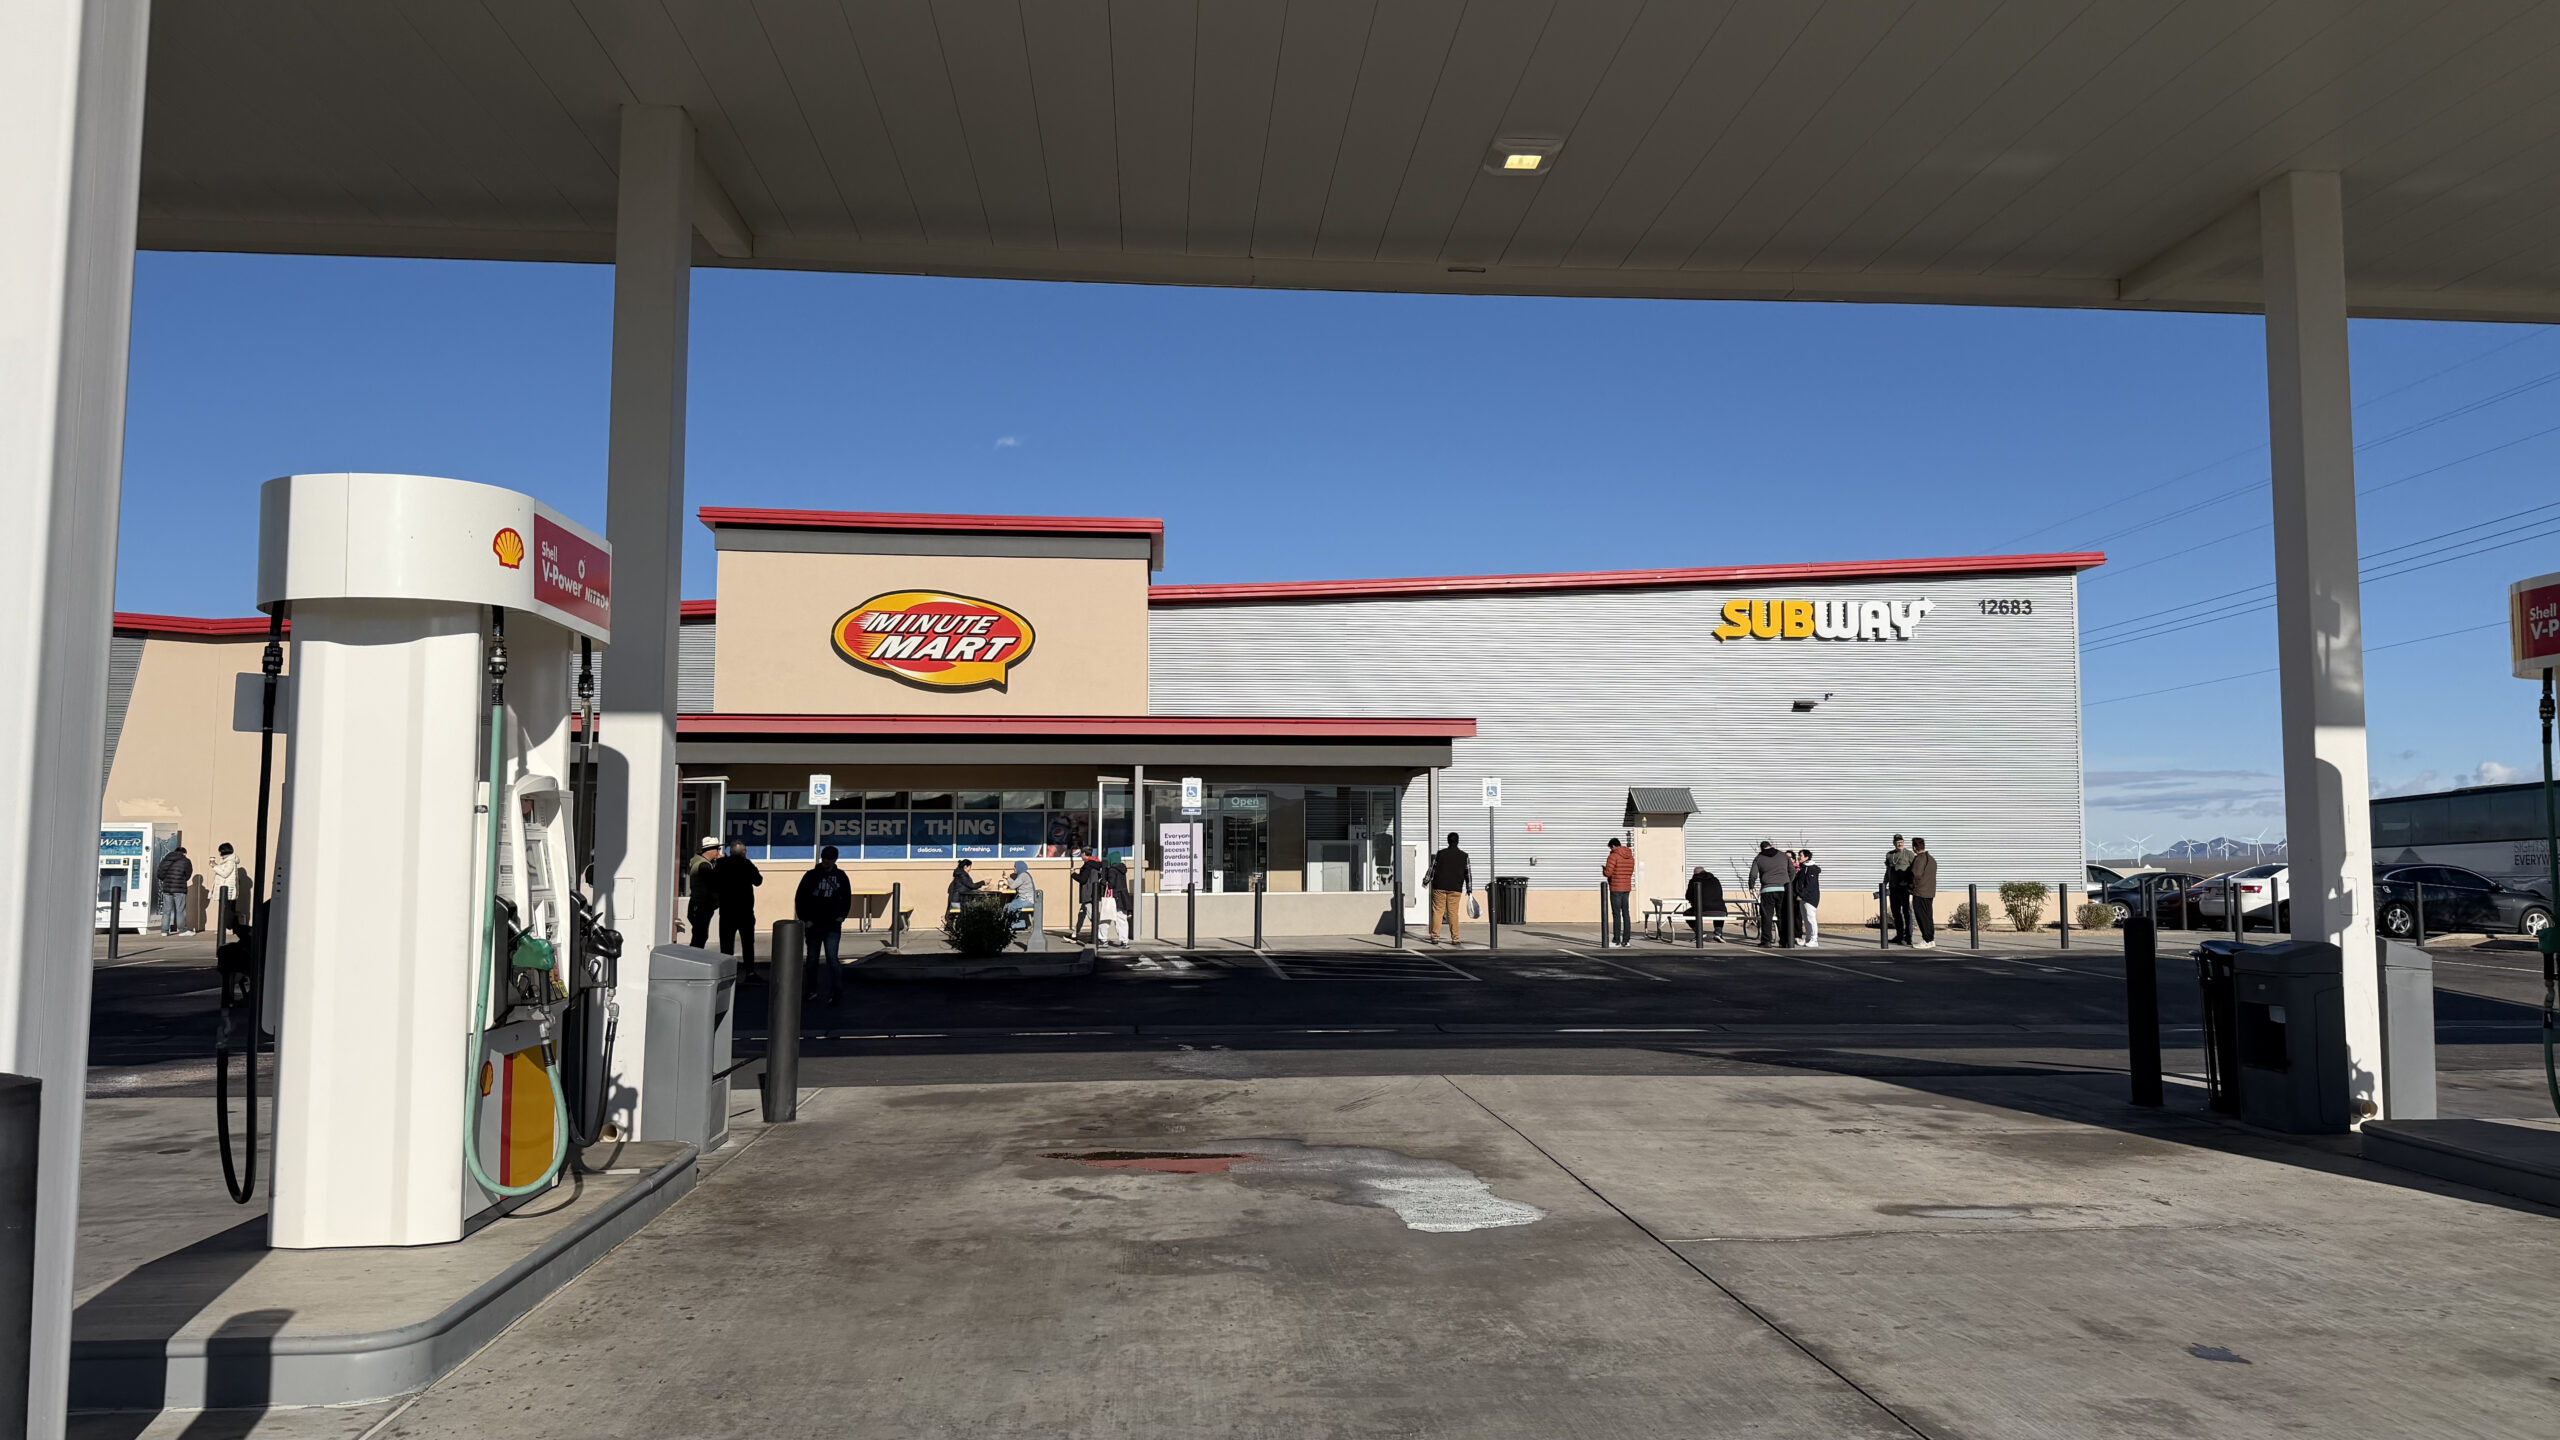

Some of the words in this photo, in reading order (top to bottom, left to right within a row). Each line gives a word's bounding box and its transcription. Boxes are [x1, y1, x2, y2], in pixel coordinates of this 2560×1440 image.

[541, 541, 558, 562] Shell
[541, 559, 583, 598] V-Power
[1978, 599, 2033, 616] 12683
[2529, 602, 2558, 621] Shell
[865, 612, 1000, 635] MINUTE
[1713, 597, 1936, 643] SUBWAY
[869, 635, 1018, 662] MART
[1231, 796, 1260, 808] Open
[726, 819, 767, 837] IT'S
[781, 819, 799, 837] A
[820, 819, 906, 837] DESERT
[924, 819, 996, 836] THING
[100, 838, 142, 847] WATER
[2513, 840, 2550, 853] SIGHTS
[1164, 867, 1199, 875] preventin.
